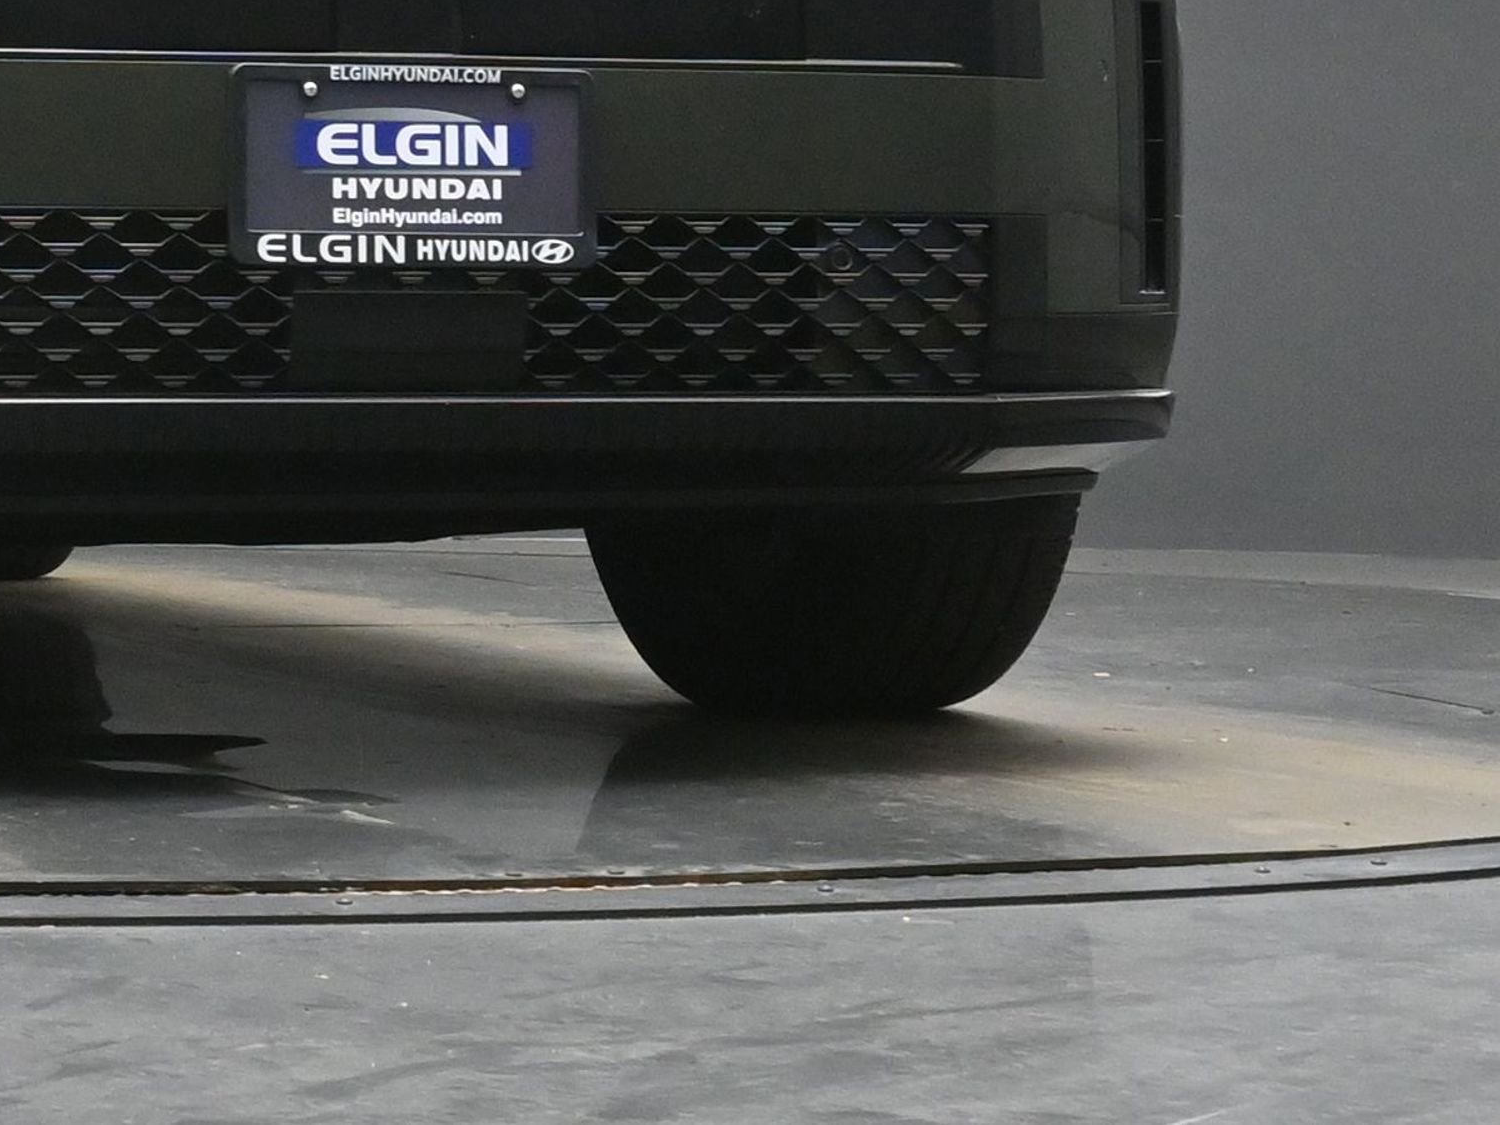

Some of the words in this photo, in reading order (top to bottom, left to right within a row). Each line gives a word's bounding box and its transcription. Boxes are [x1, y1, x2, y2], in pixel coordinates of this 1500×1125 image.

[329, 65, 501, 84] ELGINHYUNDAI.COM
[316, 123, 509, 167] ELGIN
[332, 177, 502, 200] HYUNDAI
[332, 207, 502, 228] ElginHyundai.com
[257, 234, 406, 263] ELGIN
[417, 239, 529, 262] HYUNDAI
